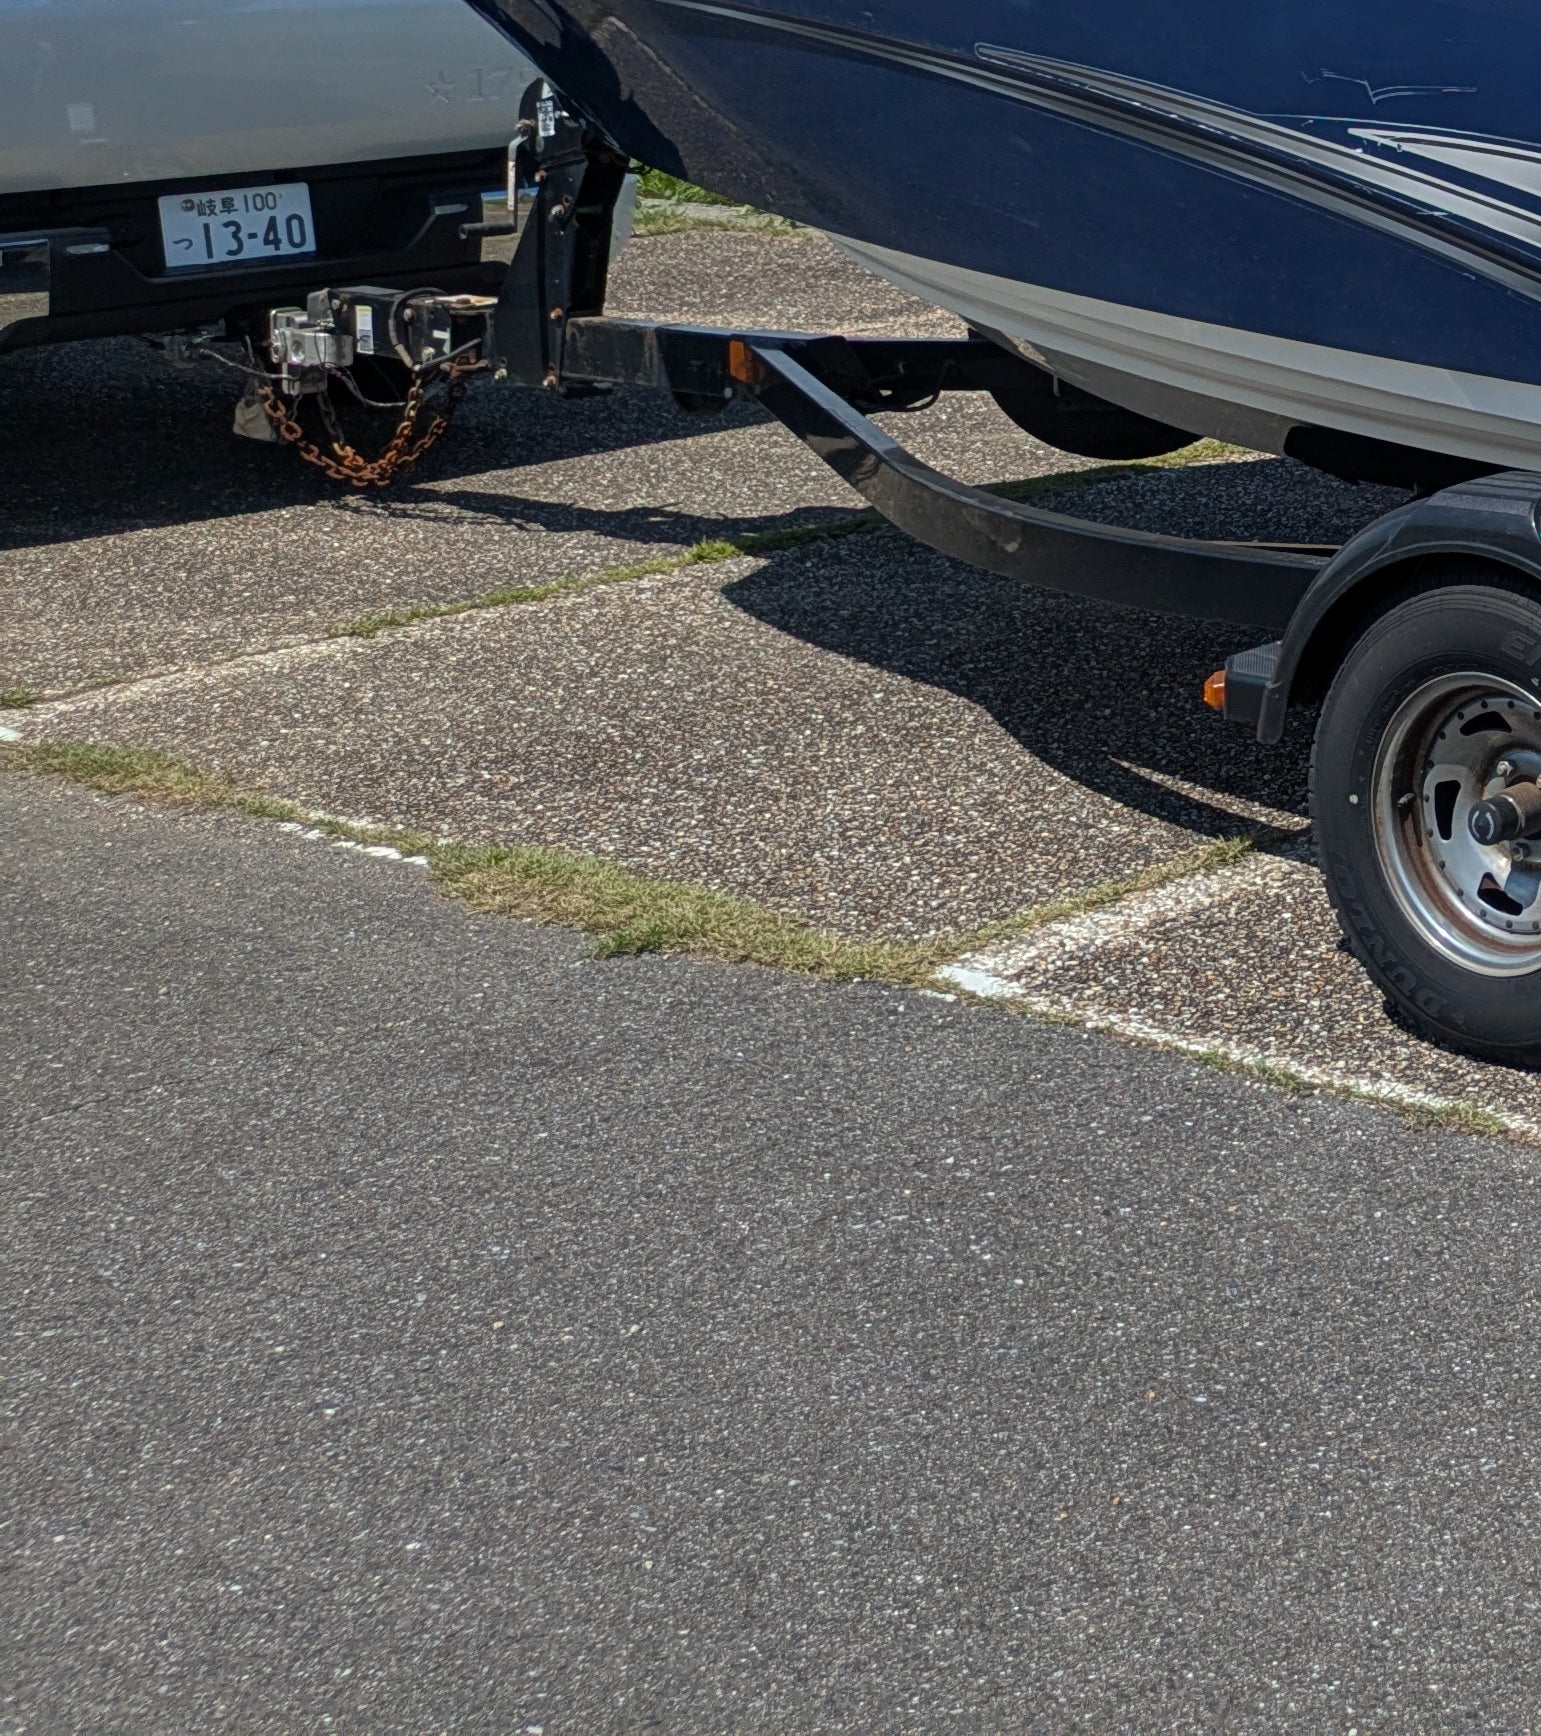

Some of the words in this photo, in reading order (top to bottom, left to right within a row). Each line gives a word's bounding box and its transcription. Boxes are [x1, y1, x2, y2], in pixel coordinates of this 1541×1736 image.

[196, 196, 239, 218] 岐阜
[243, 191, 278, 213] 100
[172, 237, 194, 251] つ
[202, 213, 307, 260] 13-40
